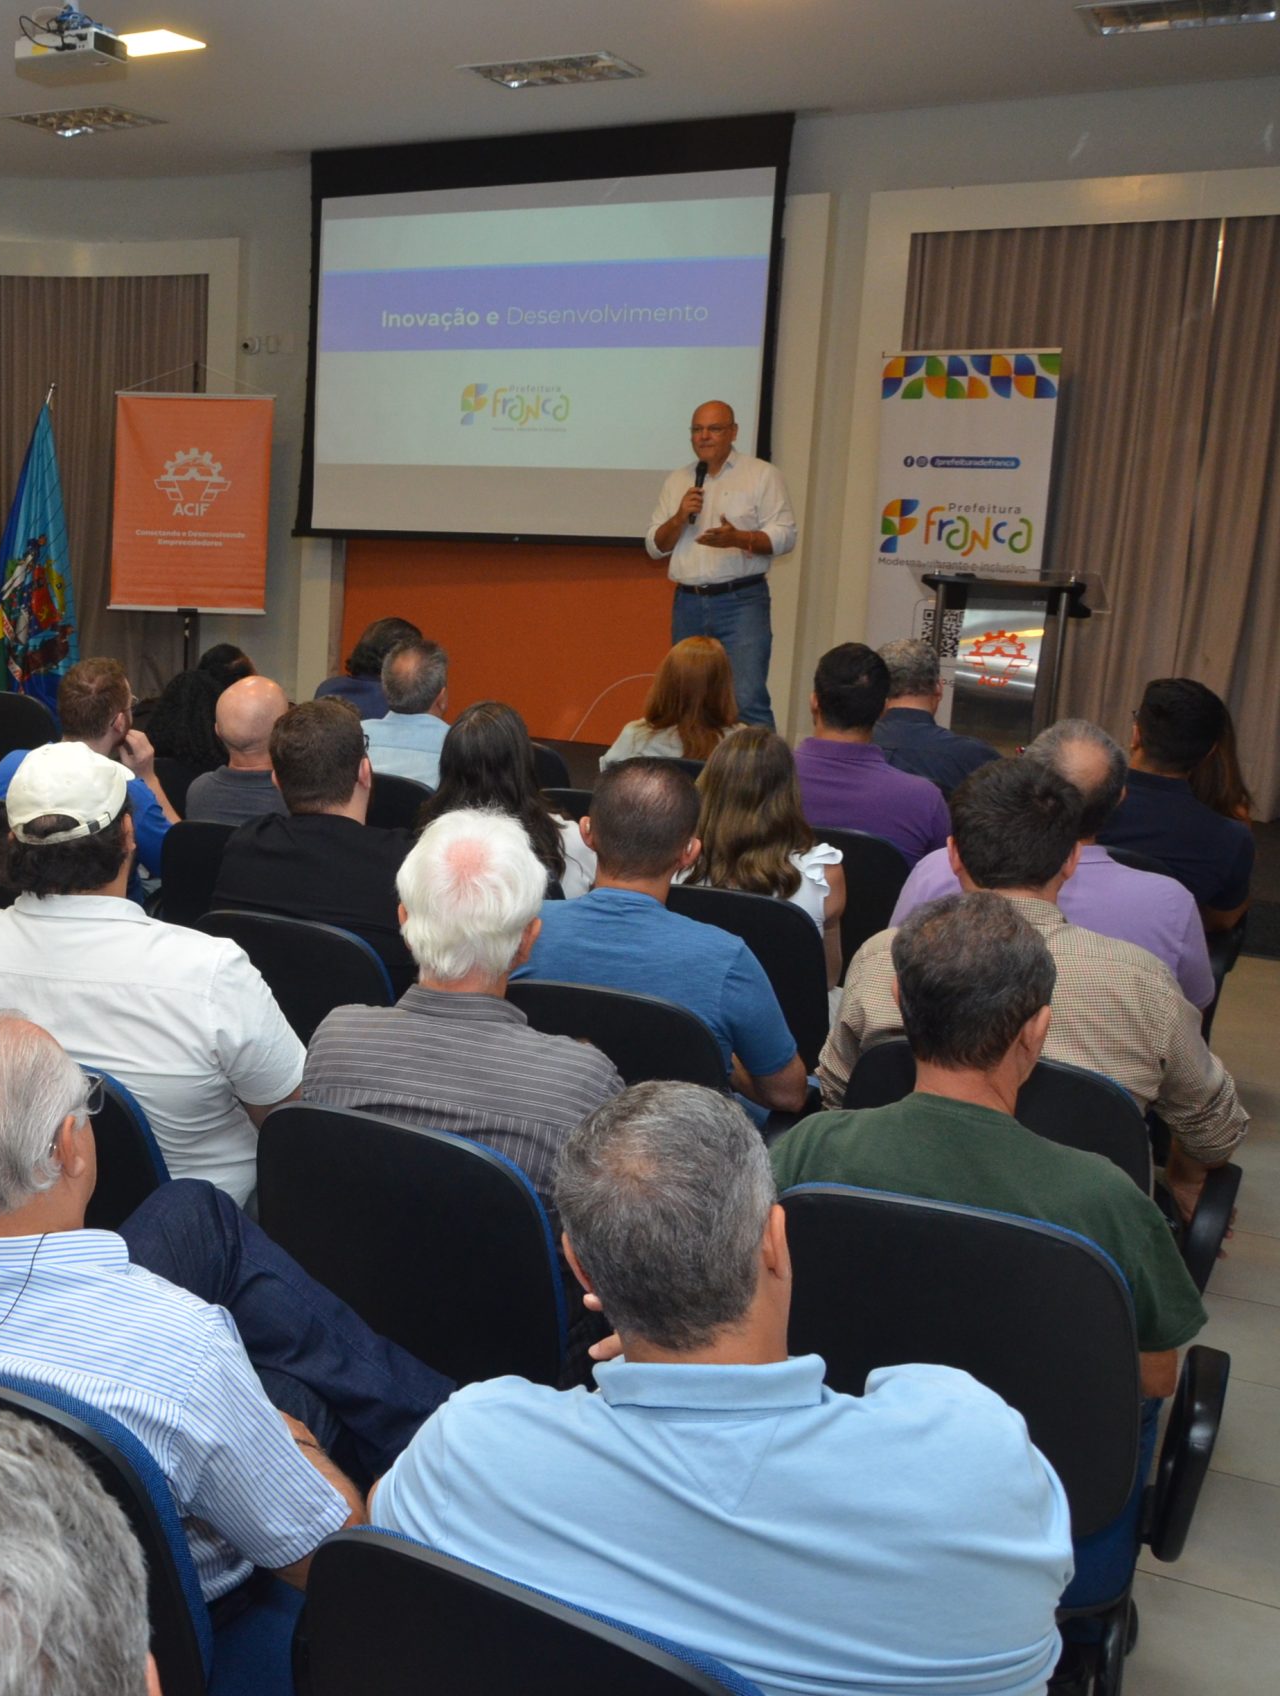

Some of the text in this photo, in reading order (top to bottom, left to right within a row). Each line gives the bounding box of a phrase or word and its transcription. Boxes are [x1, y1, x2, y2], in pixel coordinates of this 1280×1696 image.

[381, 303, 709, 331] Inovação e Desenvolvimento
[508, 384, 562, 393] Prefeitura
[172, 503, 210, 516] ACIF
[948, 502, 1023, 515] Prefeitura
